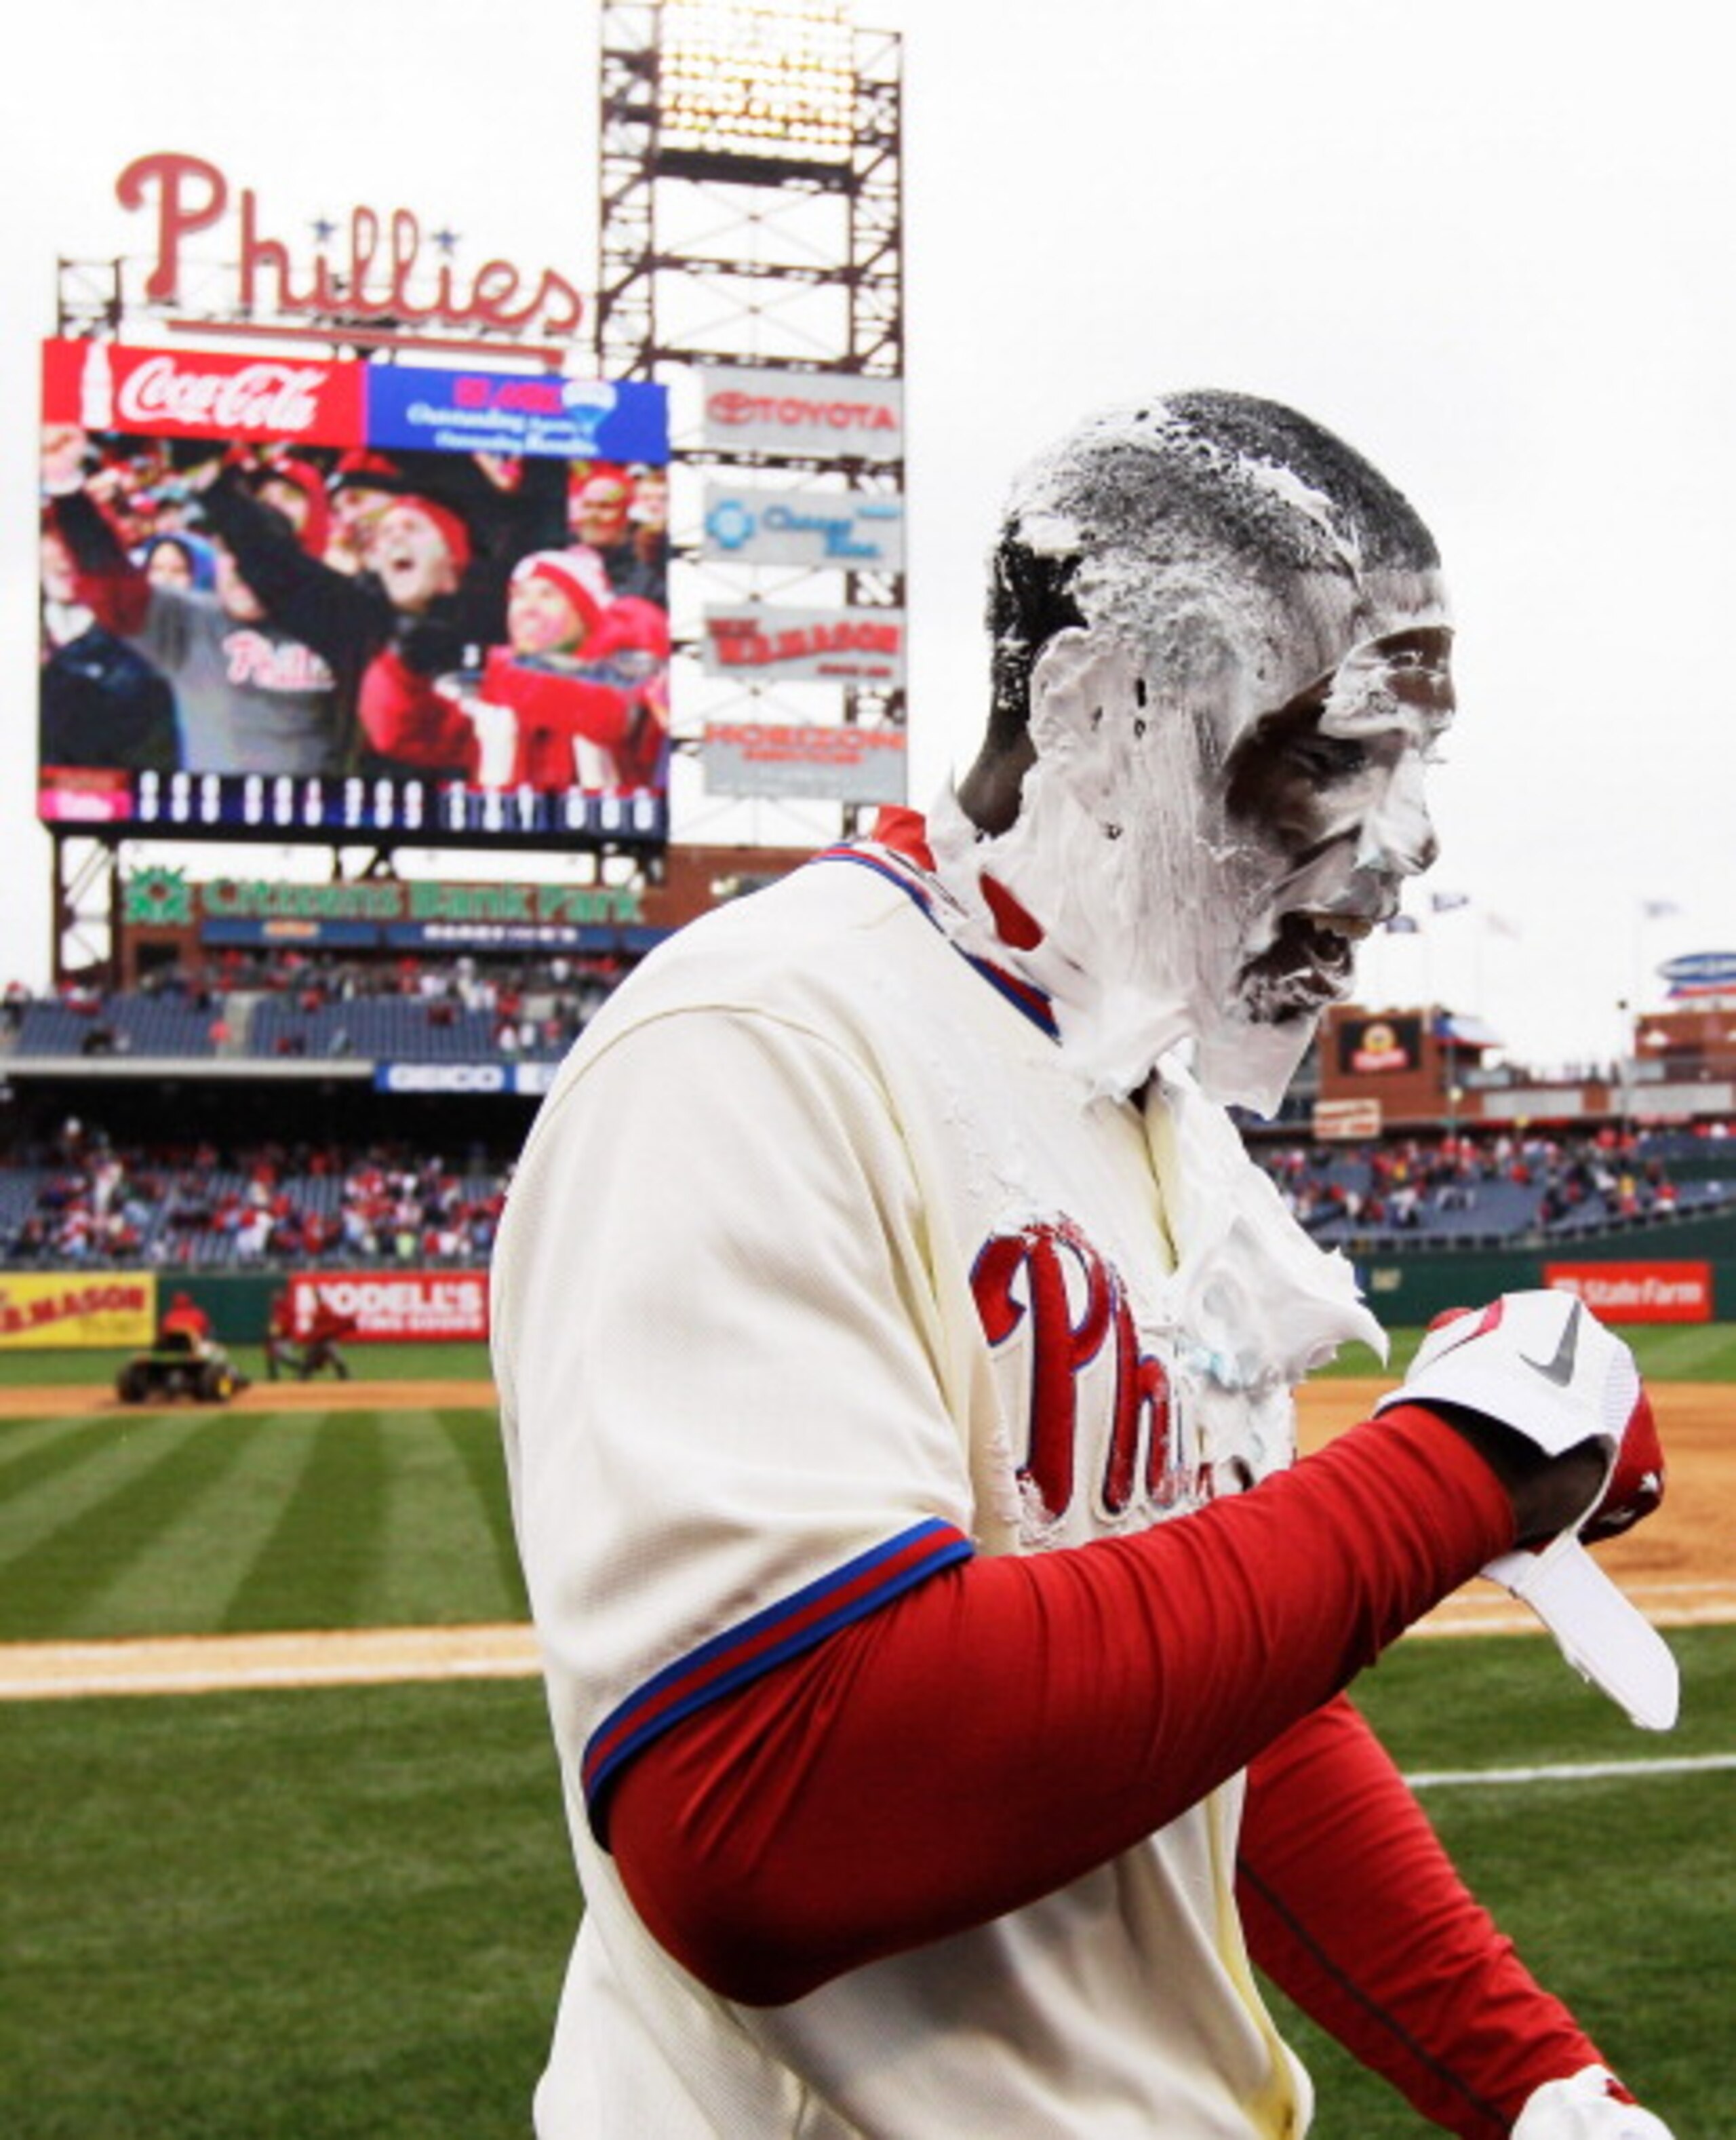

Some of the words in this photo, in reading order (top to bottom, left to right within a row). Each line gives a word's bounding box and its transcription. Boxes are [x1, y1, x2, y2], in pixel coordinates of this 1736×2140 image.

[115, 151, 583, 332] Phillies
[751, 395, 896, 432] TOYOTA
[203, 878, 399, 915] Citizens
[410, 881, 532, 918] Bank
[540, 884, 643, 923] Park
